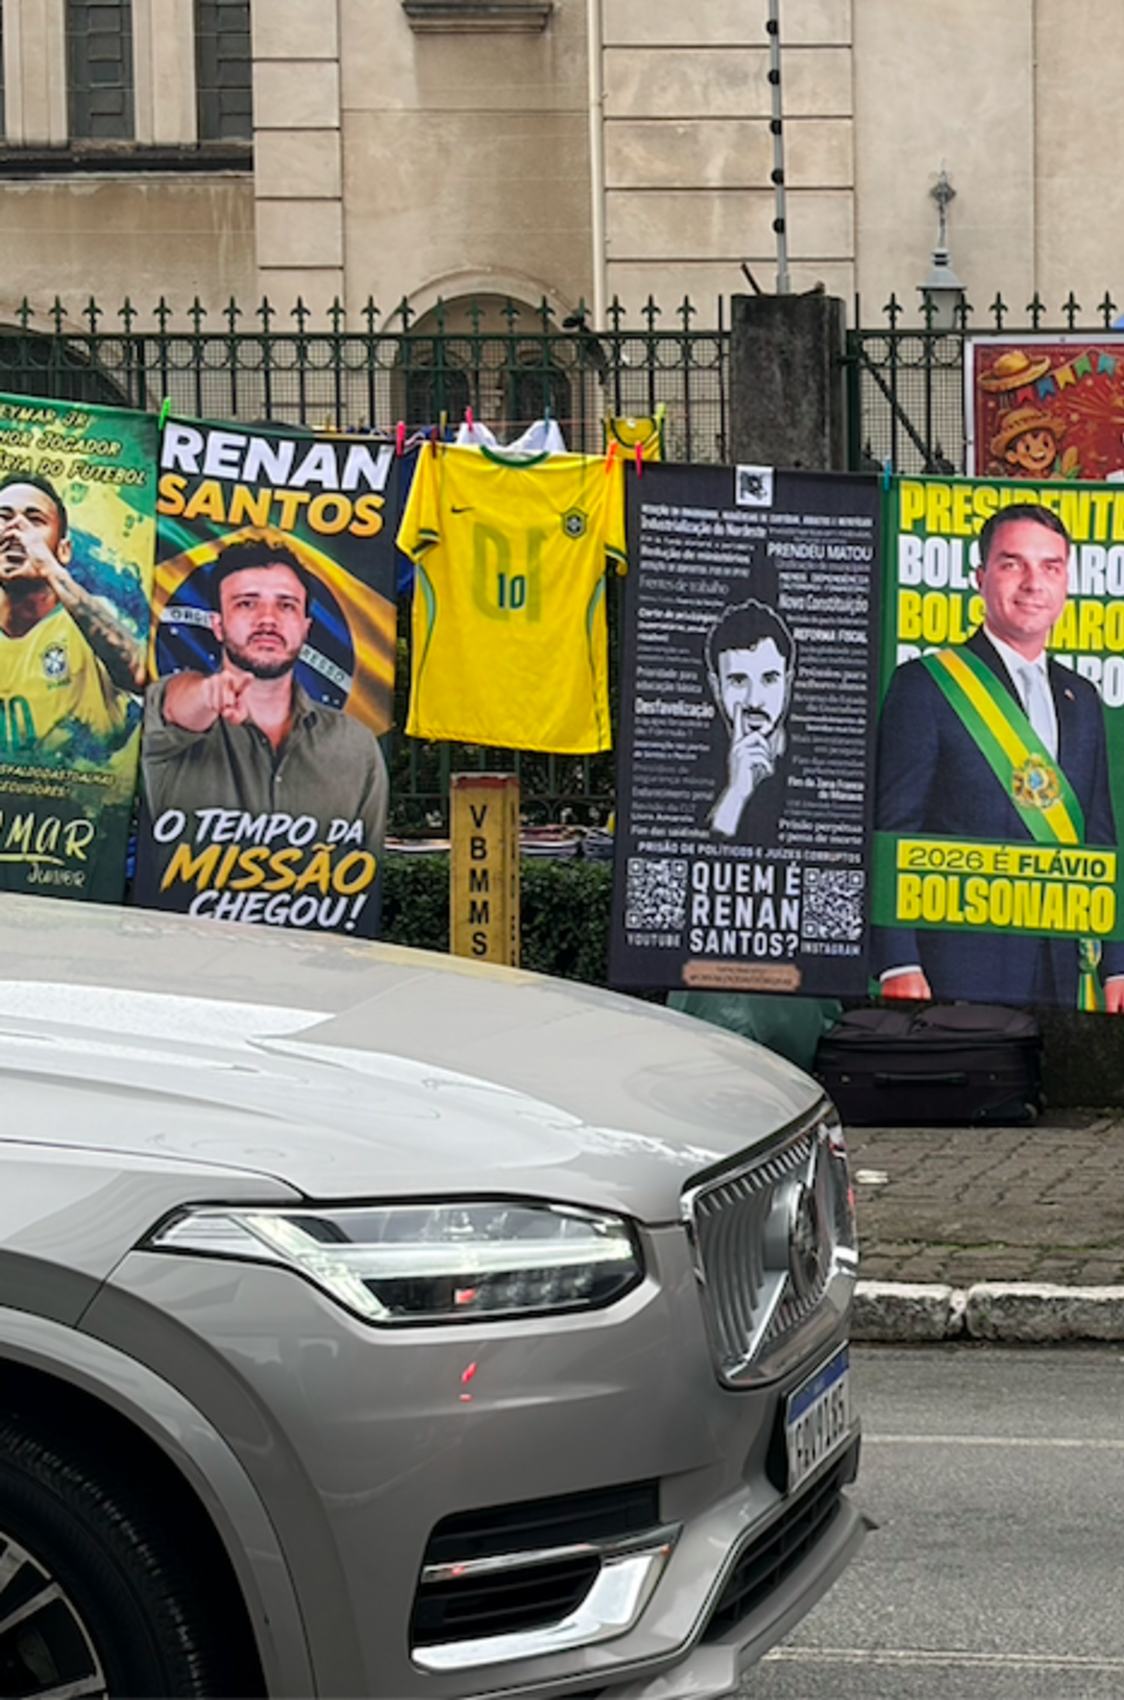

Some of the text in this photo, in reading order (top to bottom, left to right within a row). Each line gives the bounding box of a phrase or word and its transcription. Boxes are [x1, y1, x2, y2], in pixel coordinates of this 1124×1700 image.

[36, 431, 122, 457] JOGADOR
[161, 422, 395, 491] RENAN
[37, 457, 64, 476] DO
[67, 460, 147, 486] FUTEBOL
[156, 473, 386, 537] SANTOS
[497, 572, 526, 610] 10
[0, 811, 94, 860] MAR
[153, 808, 364, 846] O TEMPO DA
[159, 842, 377, 896] MISSÃO
[692, 860, 801, 895] QUEM É
[908, 845, 1107, 878] 2026 É FLÁVIO
[188, 890, 368, 931] CHEGOU!
[692, 894, 799, 931] RENAN
[896, 873, 1116, 934] BOLSONARO
[628, 933, 681, 947] YOUTUBE
[689, 929, 799, 957] SANTOS?
[801, 941, 861, 956] INSTAGRAM
